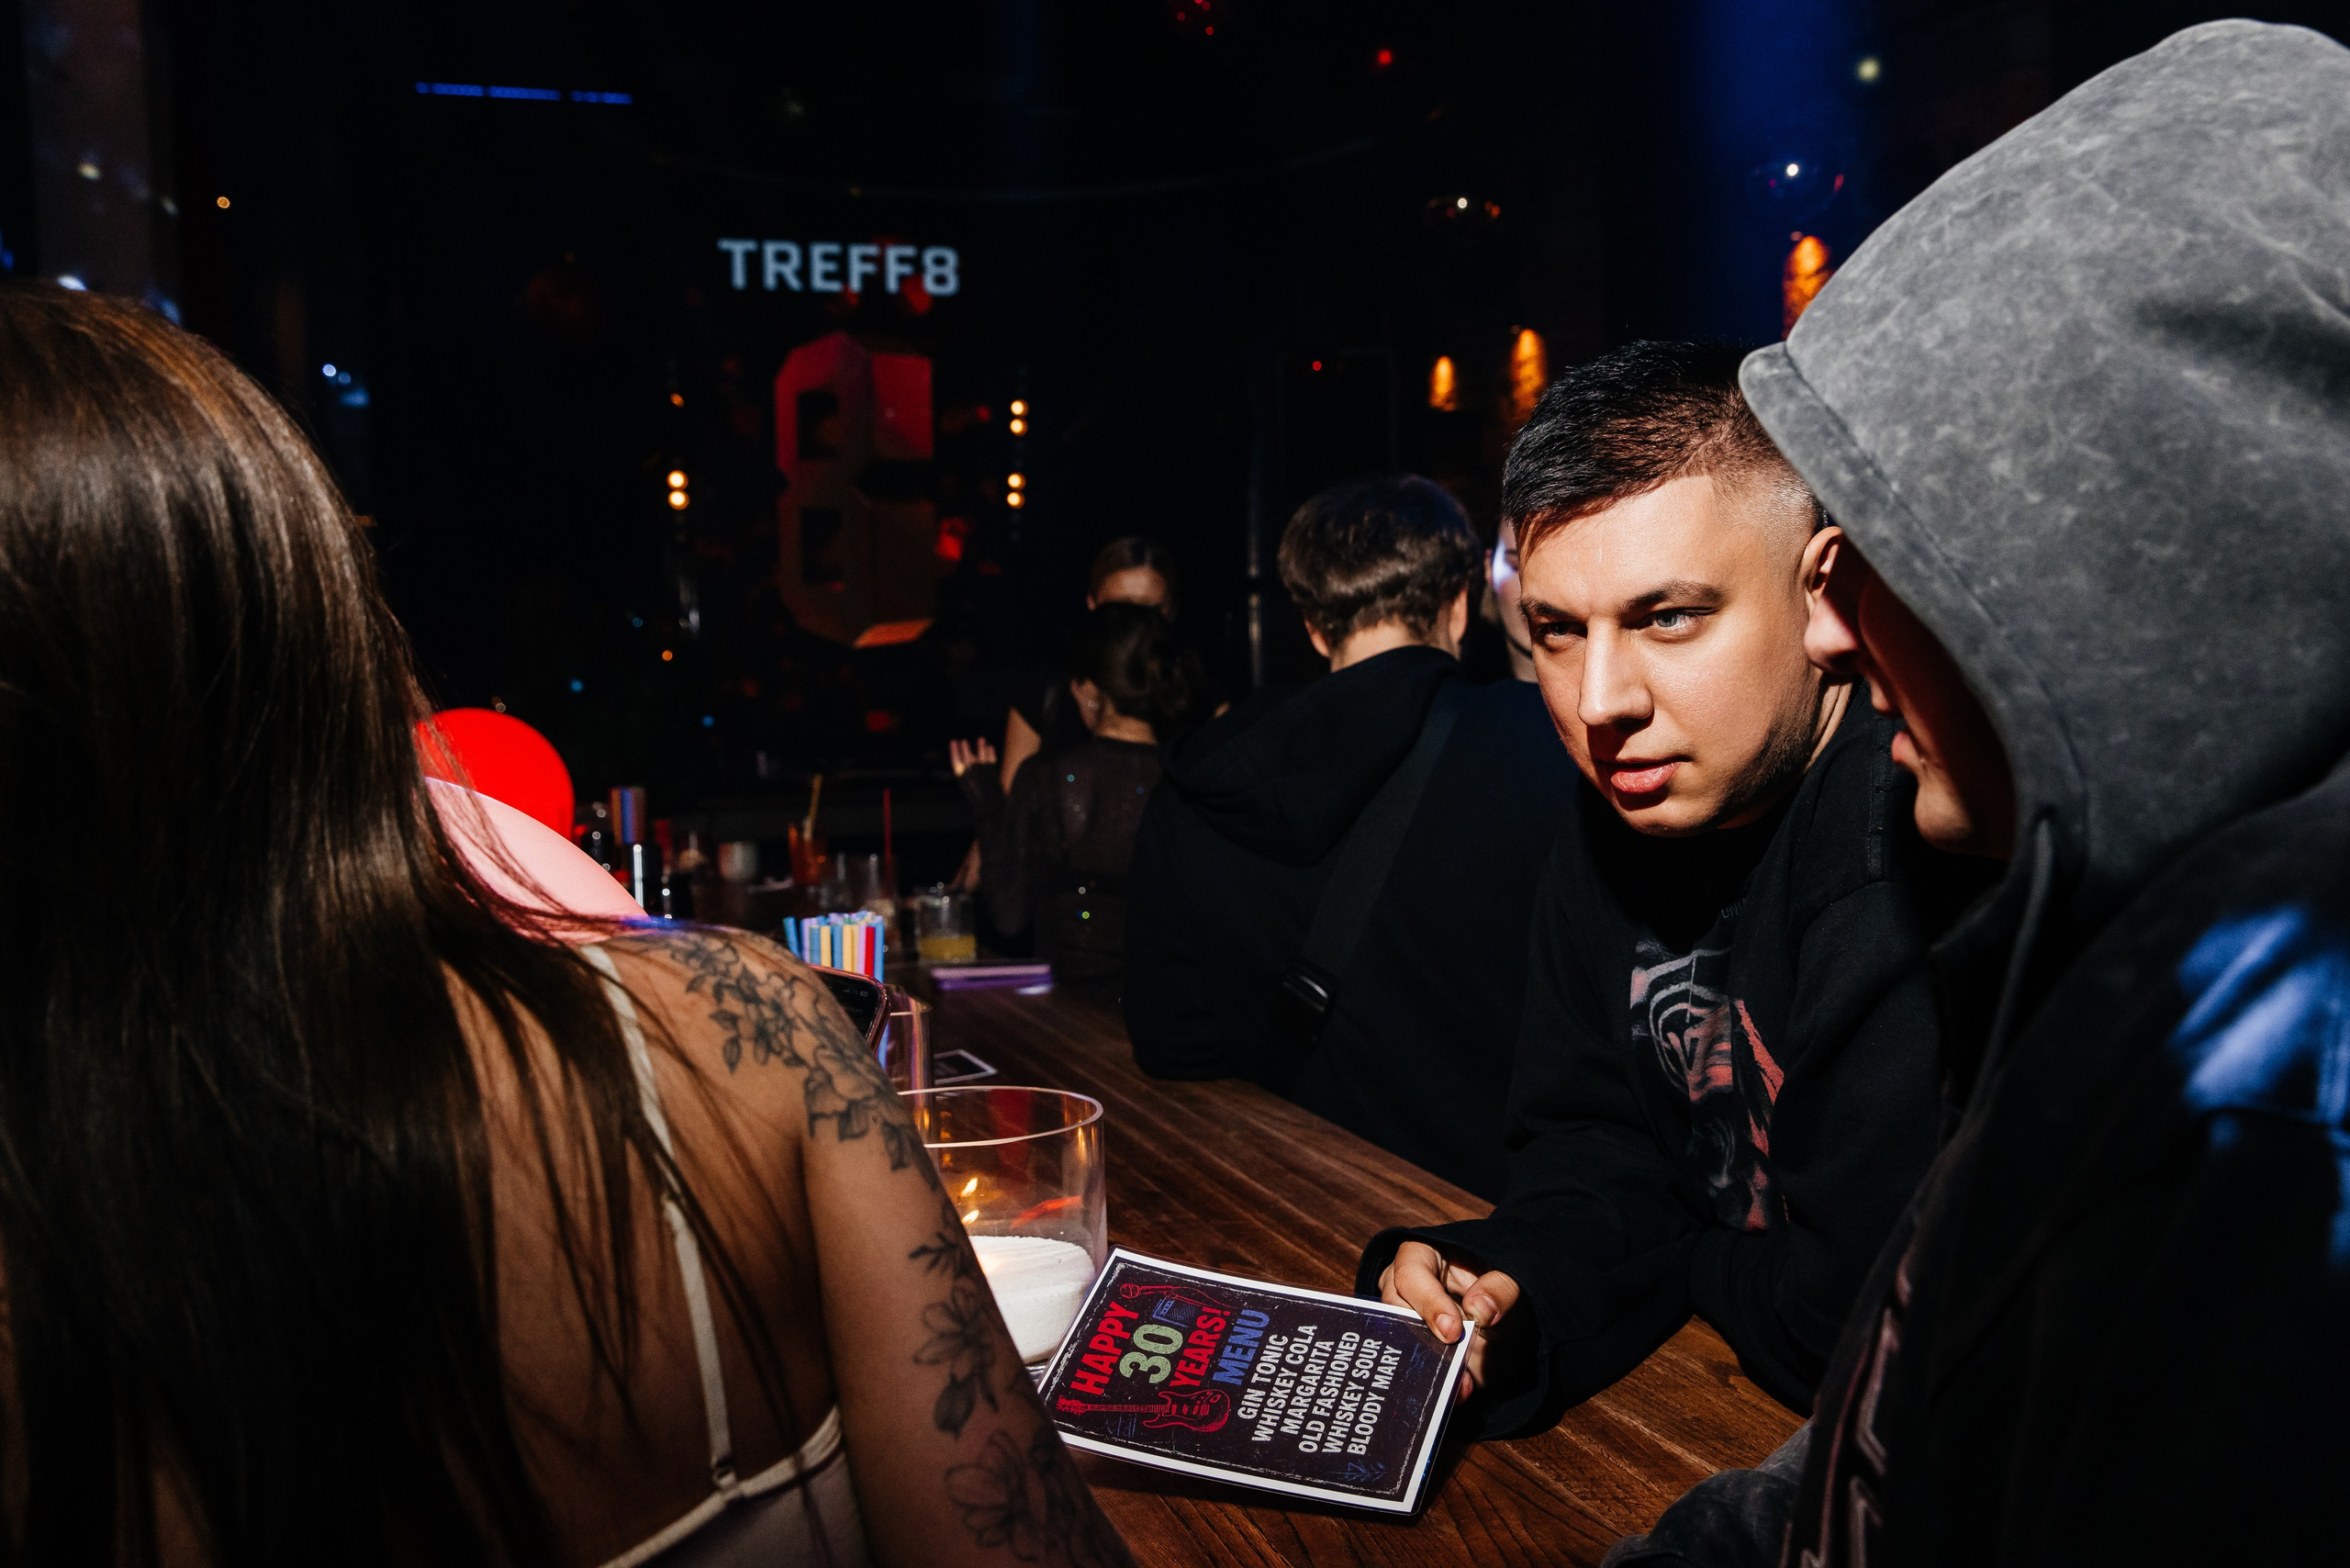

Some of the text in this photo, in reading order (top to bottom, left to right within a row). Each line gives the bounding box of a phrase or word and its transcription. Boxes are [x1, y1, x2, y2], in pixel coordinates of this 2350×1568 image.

[715, 236, 962, 297] TREFF8
[1069, 1301, 1139, 1395] HAPPY
[1119, 1324, 1183, 1383] 30
[1169, 1306, 1231, 1387] YEARS!
[1212, 1309, 1270, 1385] MENU
[1237, 1334, 1289, 1419] GIN TONIC
[1251, 1325, 1317, 1441] WHISKEY COLA
[1280, 1340, 1335, 1435] MARGARITA
[1298, 1331, 1360, 1453] OLD FASHIONED
[1322, 1338, 1382, 1453] WHISKEY SOUR
[1347, 1345, 1403, 1456] BLOODY MARY
